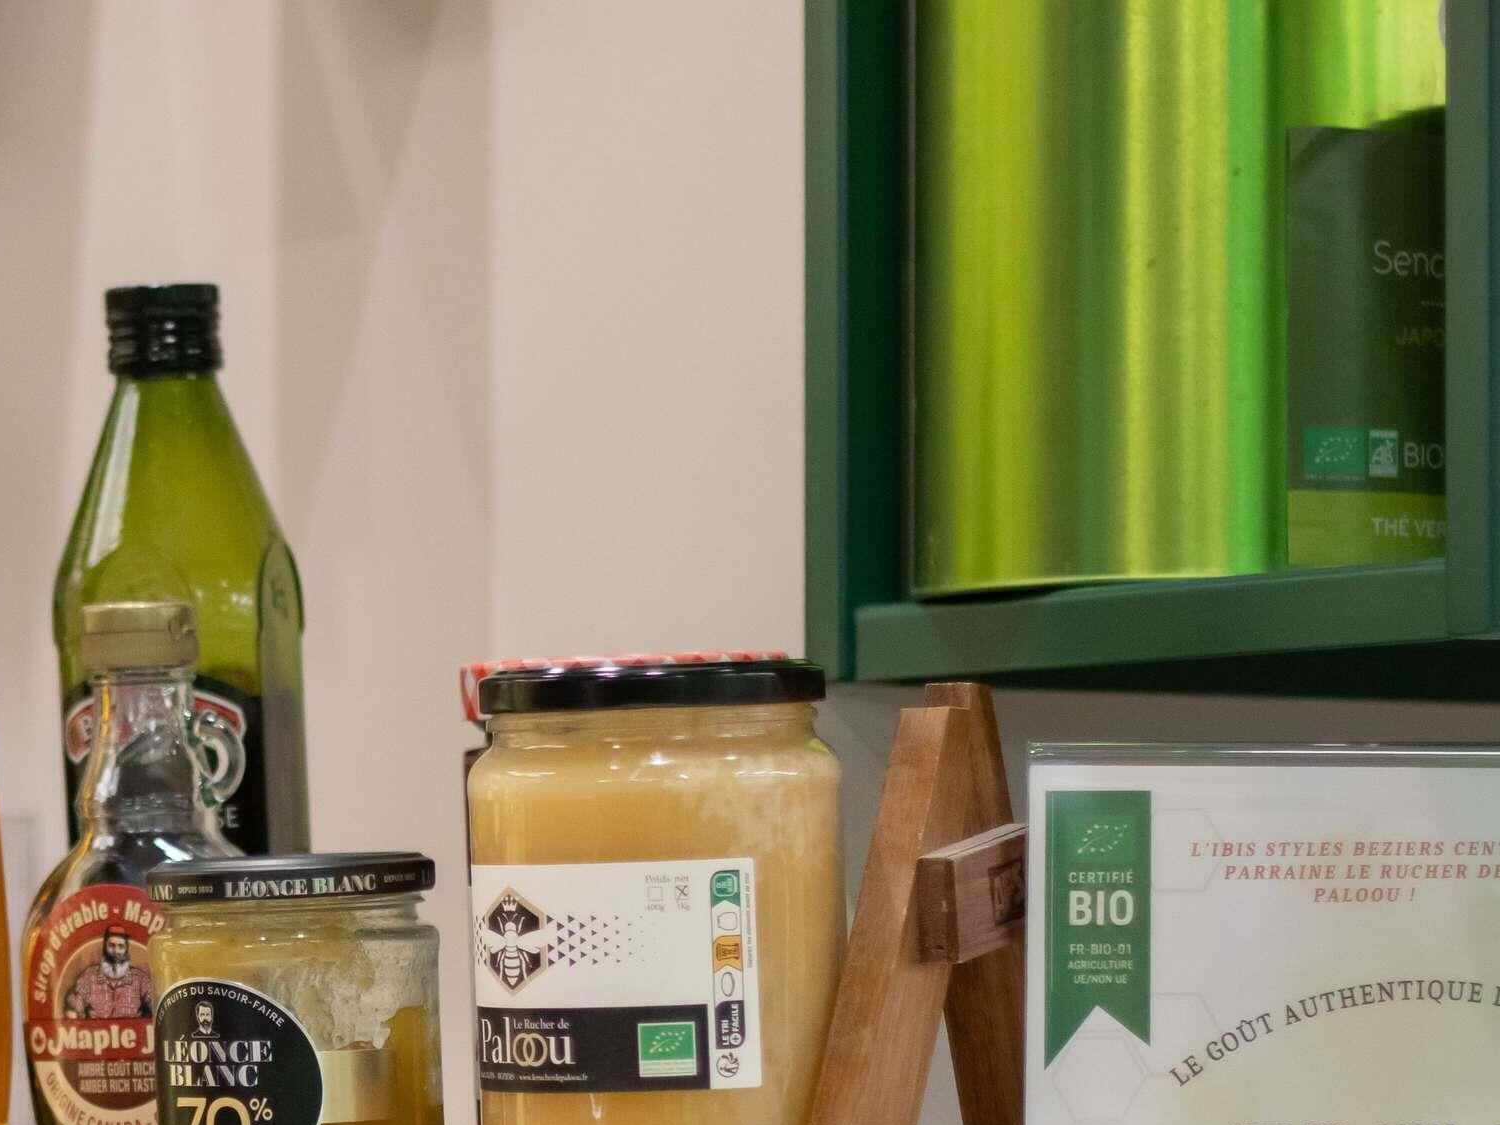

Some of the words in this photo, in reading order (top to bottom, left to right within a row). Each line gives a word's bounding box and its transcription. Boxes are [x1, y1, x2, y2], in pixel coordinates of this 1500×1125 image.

[1372, 512, 1409, 538] THÉ
[1191, 841, 1256, 857] L'IBIS
[1265, 841, 1344, 857] STYLES
[1352, 840, 1446, 857] BEZIERS
[1454, 840, 1500, 856] CEN
[1069, 871, 1134, 883] CERTIFIÉ
[1224, 864, 1336, 880] PARRAINE
[1345, 865, 1372, 880] LE
[1380, 864, 1468, 880] RUCHER
[224, 876, 308, 899] LÉONCE
[312, 873, 377, 896] BLANC
[1313, 887, 1401, 903] PALOOU
[1068, 890, 1134, 926] BIO
[1069, 943, 1132, 955] FR-BIO-01
[1068, 960, 1134, 970] AGRICULTURE
[34, 948, 56, 1003] Sirop
[190, 985, 205, 997] DU
[513, 1019, 523, 1030] Le
[525, 1018, 555, 1030] Rucher
[557, 1018, 570, 1030] de
[47, 1024, 137, 1055] Maple
[1169, 1055, 1204, 1087] LE
[1206, 1012, 1275, 1062] GOÛT
[1284, 979, 1484, 1026] AUTHENTIQUE
[163, 1034, 273, 1064] LÉONCE
[169, 1064, 259, 1088] BLANC
[80, 1078, 107, 1093] AMBER
[109, 1078, 131, 1093] RICH
